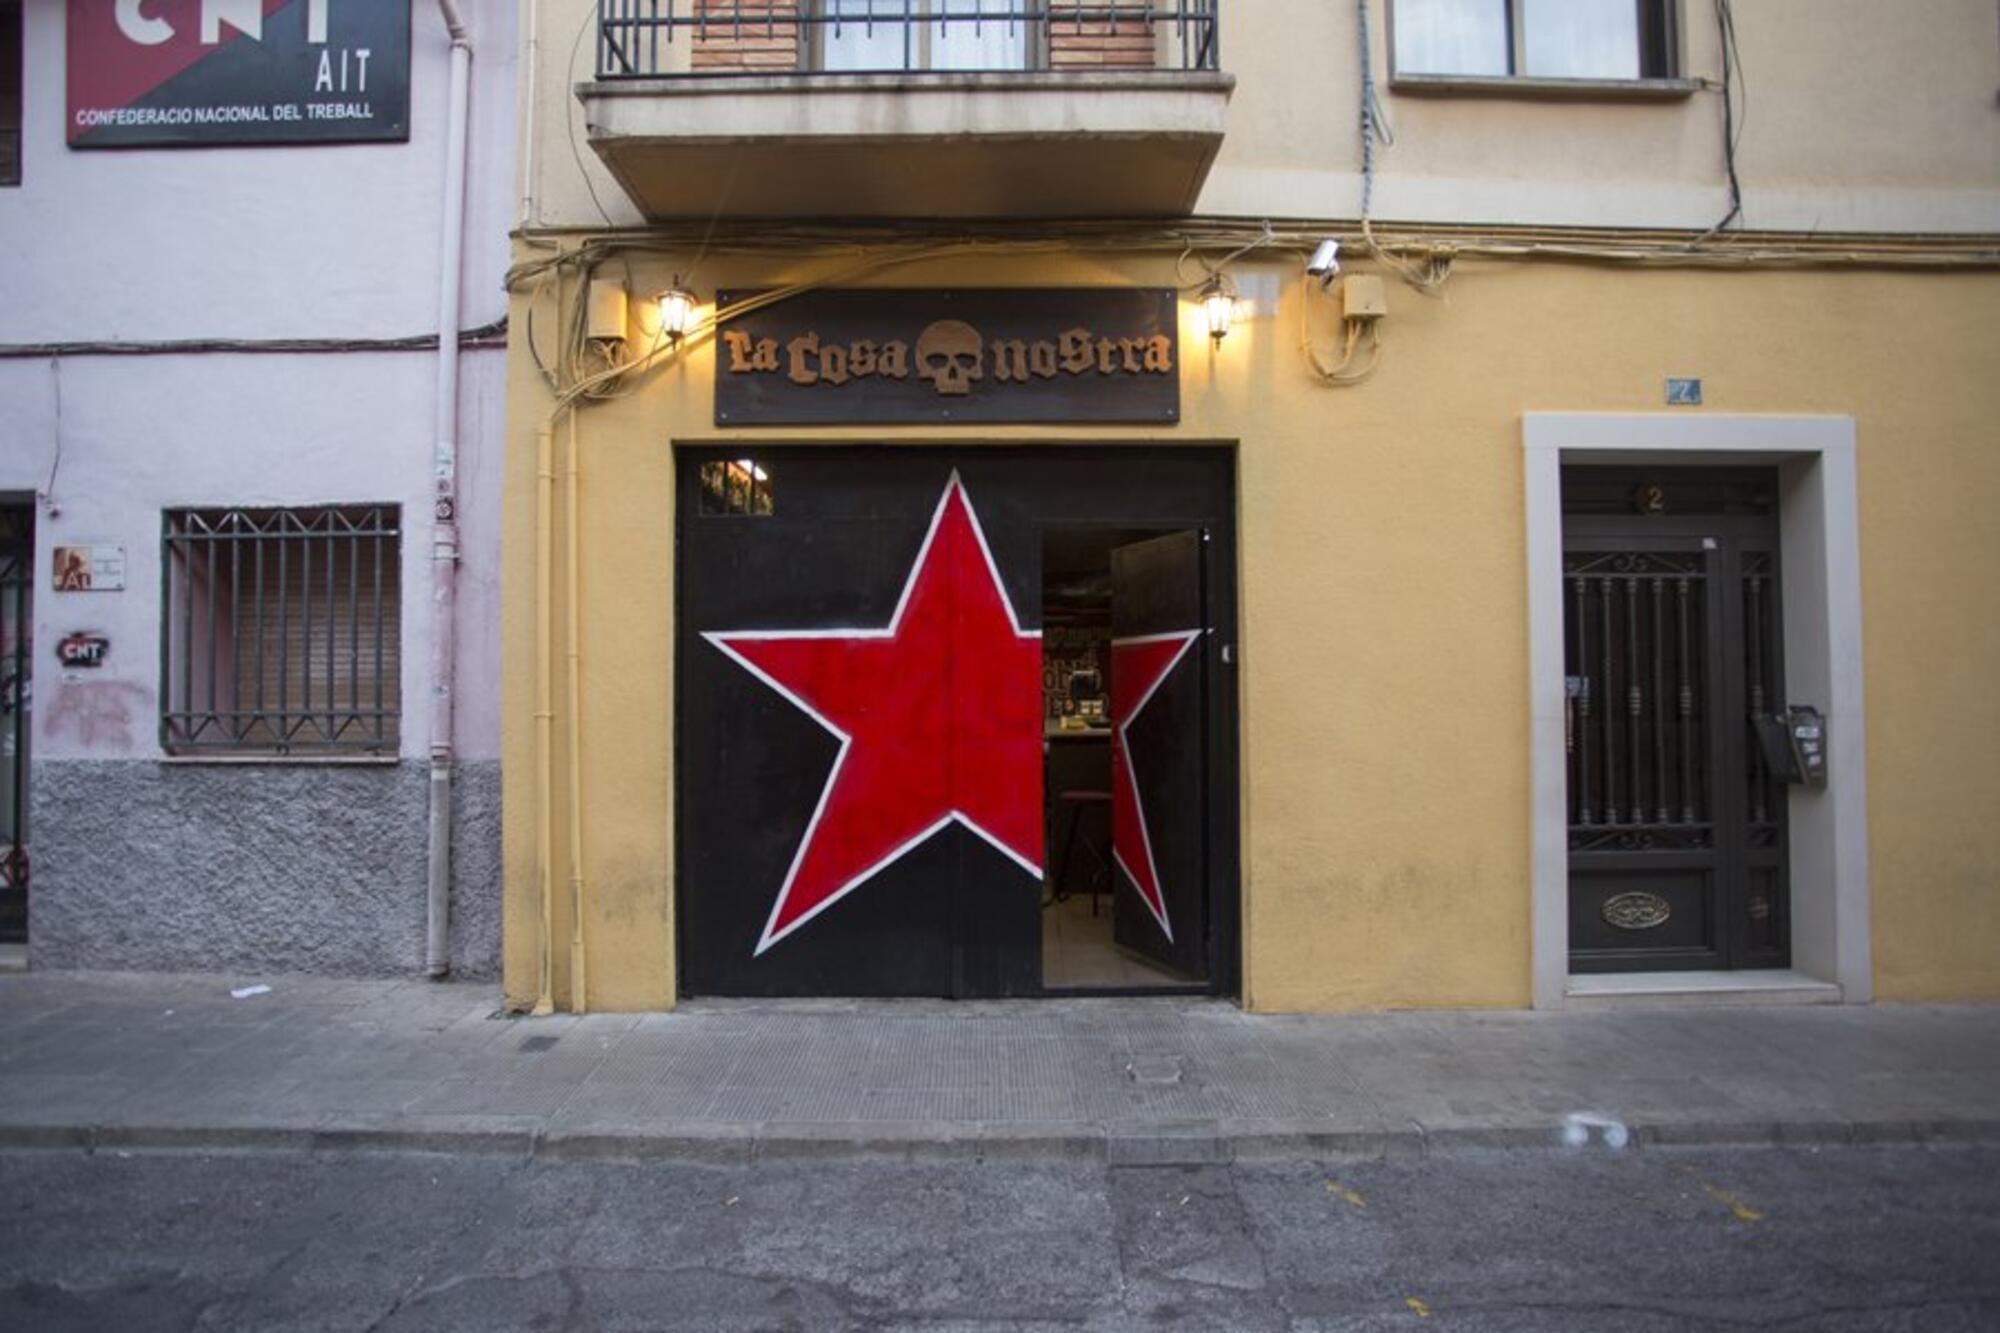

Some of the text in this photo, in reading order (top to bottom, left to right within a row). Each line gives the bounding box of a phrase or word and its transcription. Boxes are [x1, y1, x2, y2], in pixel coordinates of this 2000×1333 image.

[315, 49, 371, 92] AIT
[76, 102, 373, 126] CONFEDERACIO NACIONAL DEL TREBALL
[723, 329, 778, 373] La
[786, 330, 909, 385] Cosa
[1648, 486, 1664, 510] 2
[64, 643, 101, 660] CNT
